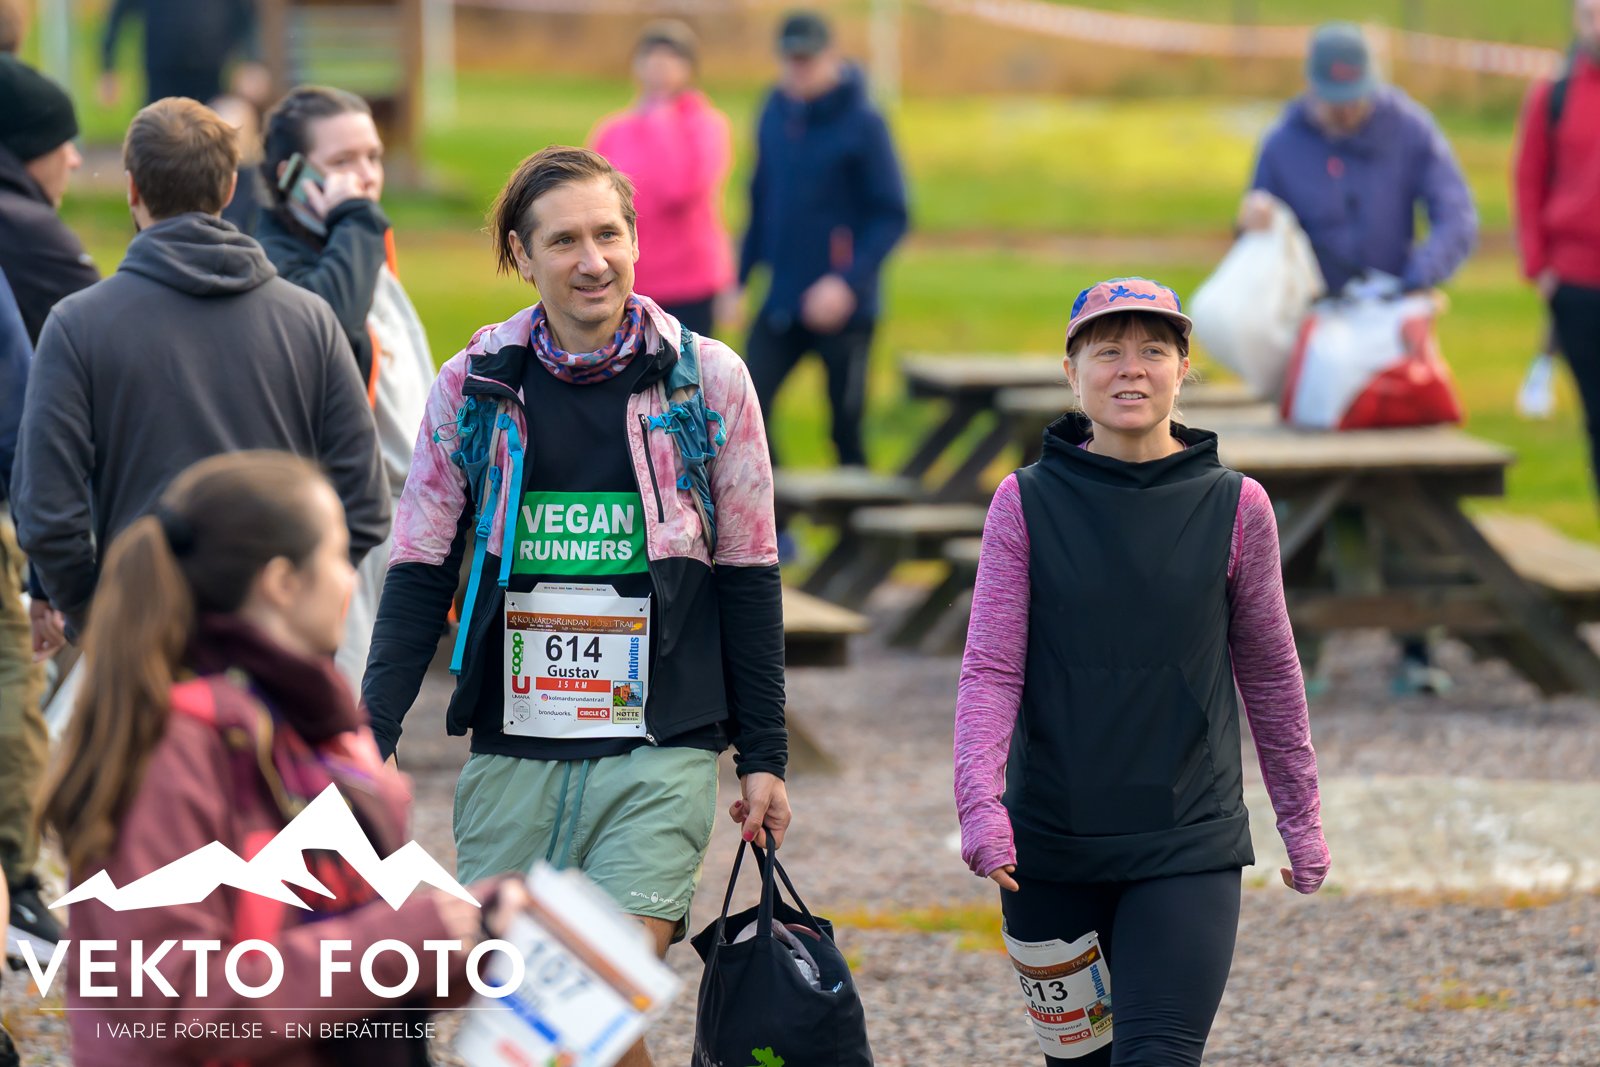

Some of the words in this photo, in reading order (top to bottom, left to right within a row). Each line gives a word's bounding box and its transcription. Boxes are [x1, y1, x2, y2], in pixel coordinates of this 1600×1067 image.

[521, 503, 635, 534] VEGAN
[519, 539, 633, 560] RUNNERS
[511, 631, 524, 676] coop
[545, 634, 603, 663] 614
[628, 636, 640, 680] Aktivitus
[547, 664, 600, 679] Gustav
[1019, 975, 1069, 1002] 613
[1030, 1000, 1065, 1014] Anna
